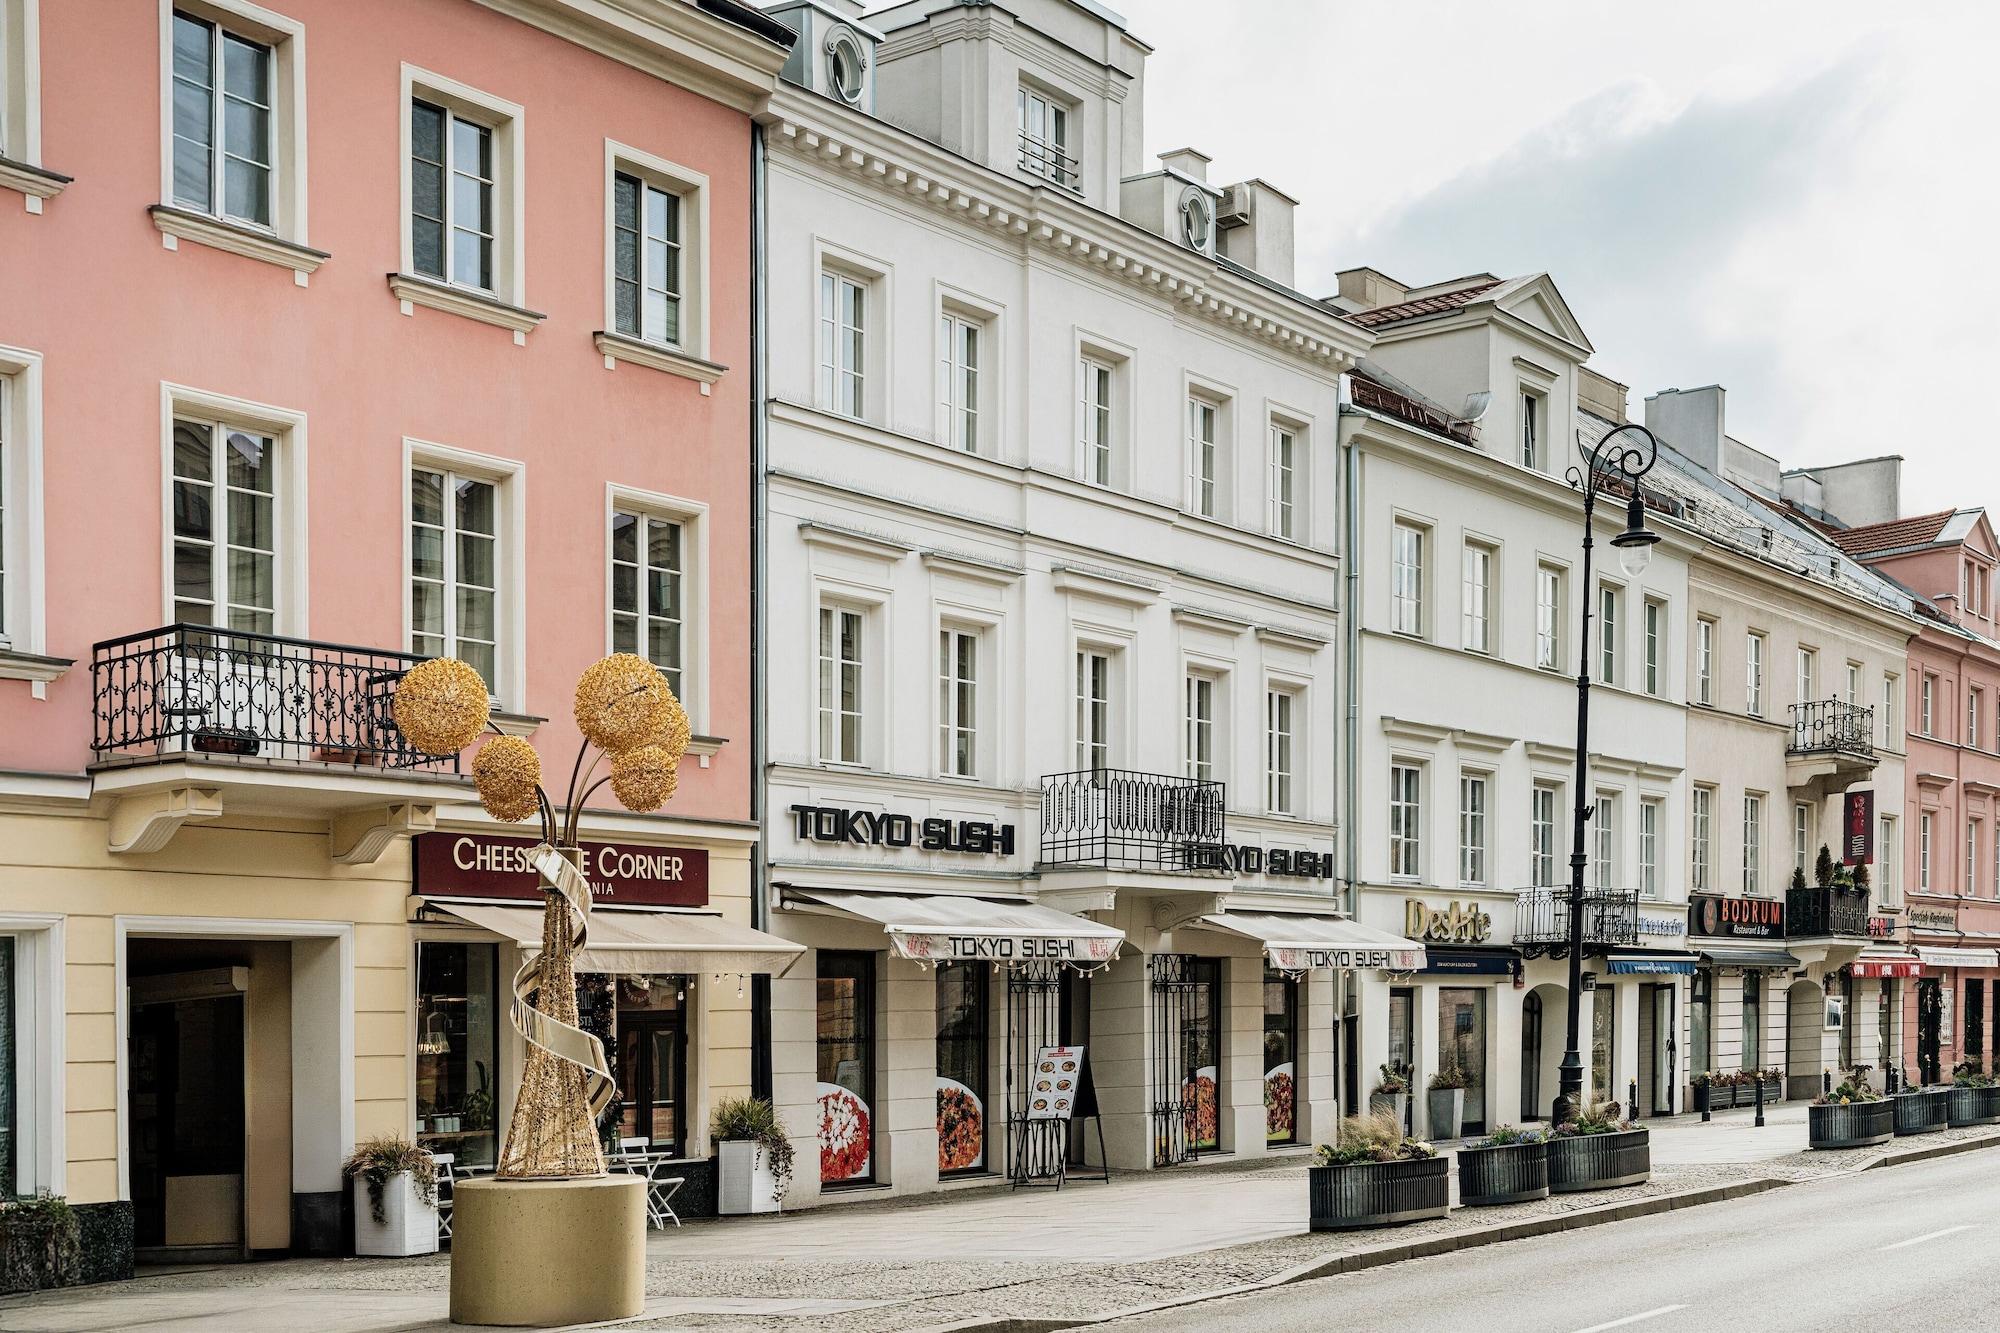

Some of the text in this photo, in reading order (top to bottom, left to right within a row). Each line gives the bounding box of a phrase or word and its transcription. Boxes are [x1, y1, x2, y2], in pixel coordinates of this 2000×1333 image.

[791, 804, 1015, 855] TOKYO SUSHI
[1852, 834, 1864, 856] SUSHI
[598, 846, 684, 881] CORNER
[1183, 841, 1333, 879] TOKYO SUSHI
[1722, 898, 1780, 925] BODRUM
[1733, 924, 1757, 935] Restaurant
[1761, 925, 1770, 936] Bar
[949, 936, 1075, 958] TOKYO SUSHI
[1089, 938, 1109, 957] 東京
[1307, 950, 1390, 967] TOKYO SUSHI
